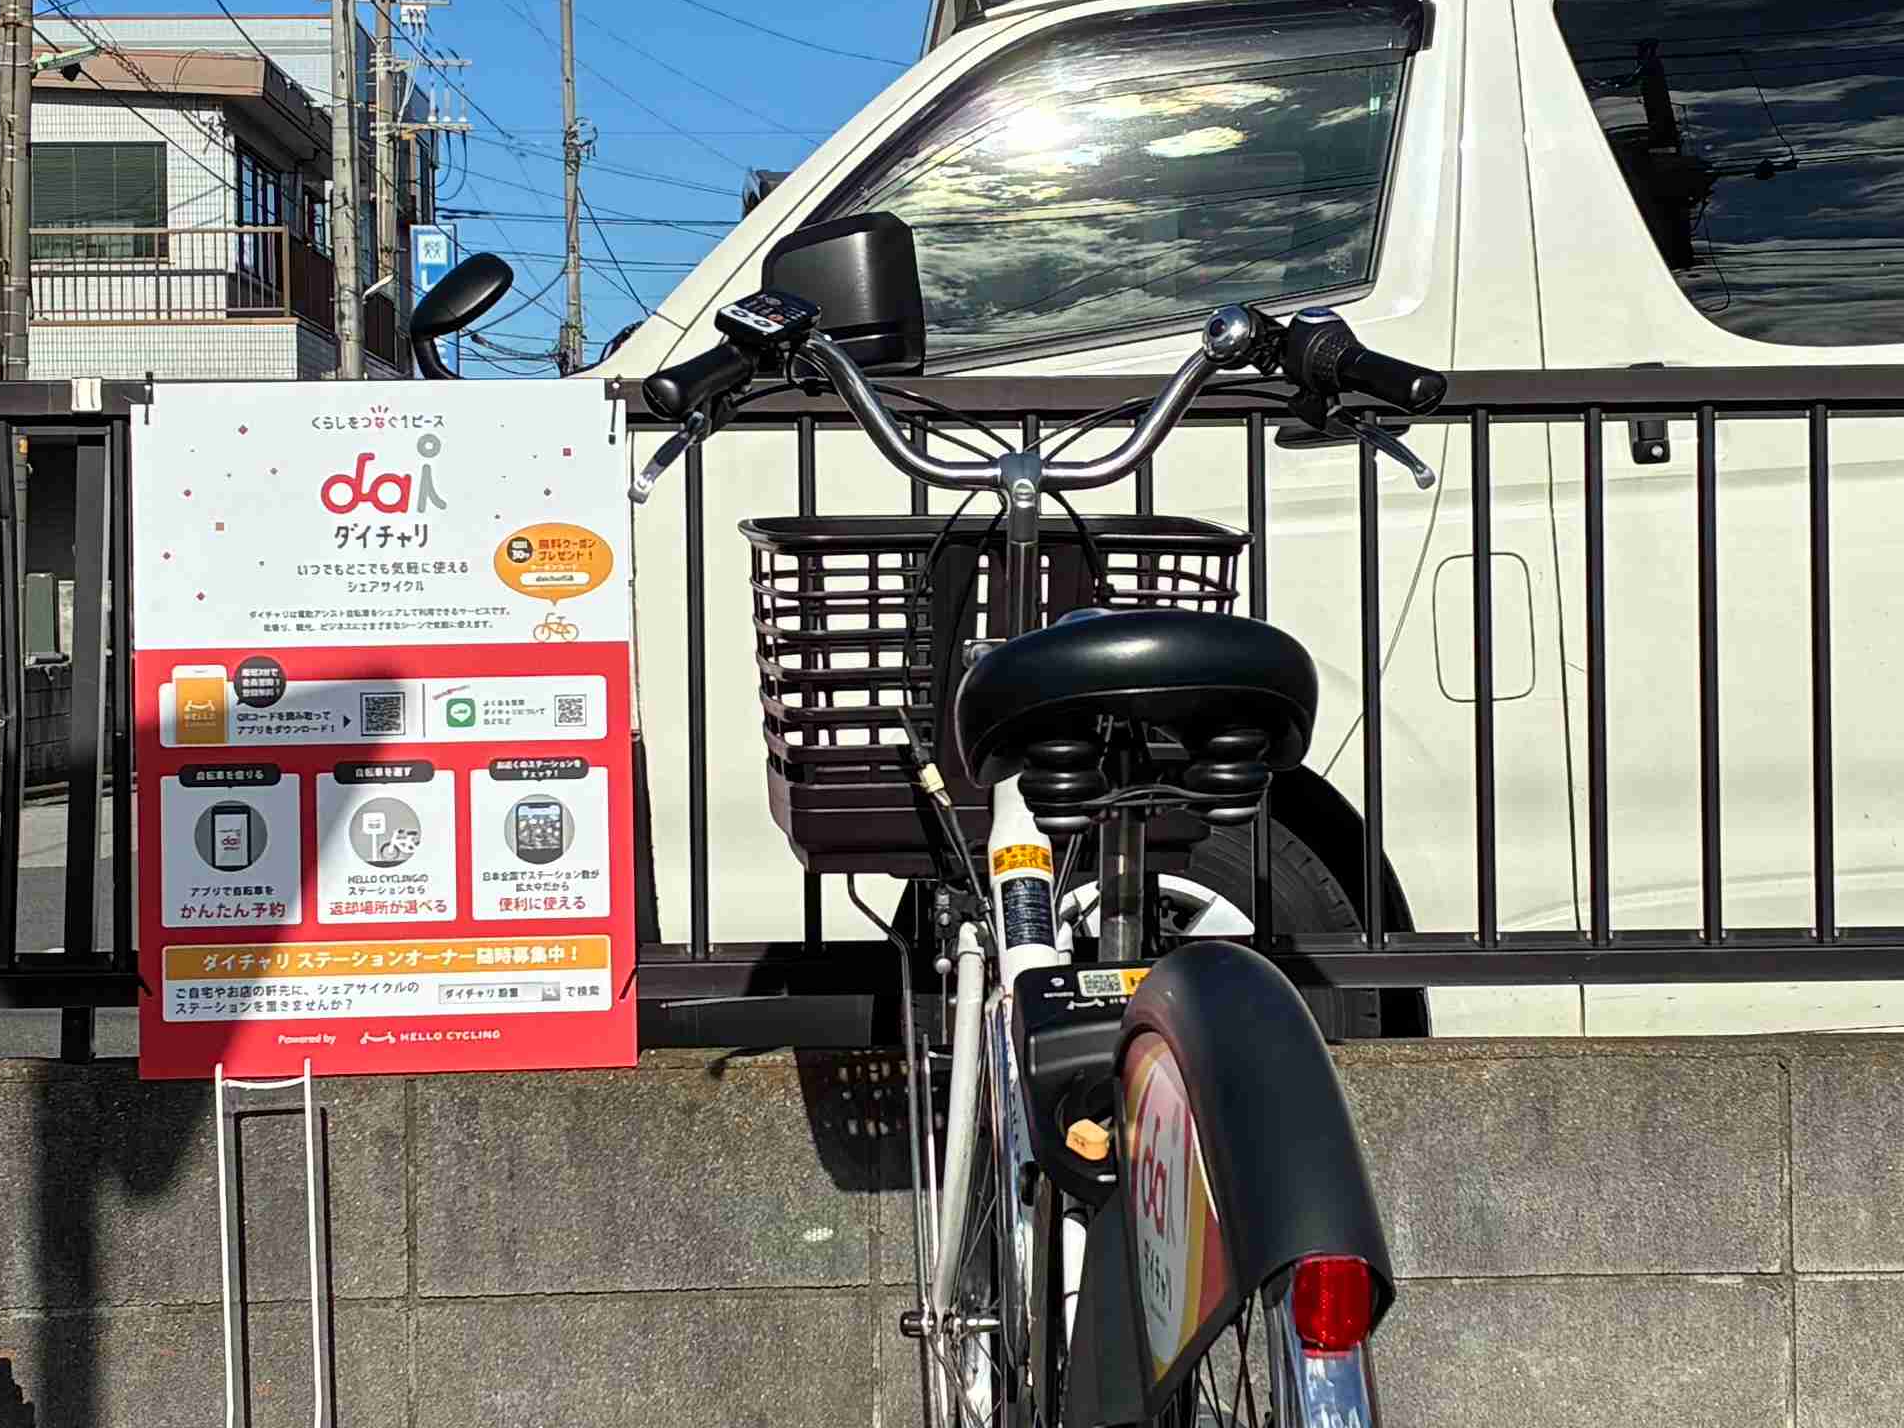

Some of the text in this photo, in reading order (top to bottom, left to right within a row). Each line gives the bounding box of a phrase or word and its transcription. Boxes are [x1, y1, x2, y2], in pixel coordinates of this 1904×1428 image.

[311, 414, 446, 430] くらしをつなぐ1ピース
[320, 433, 447, 514] dai
[334, 523, 429, 549] ダイチャリ
[296, 560, 470, 576] いつでもどこでも気軽に使える
[347, 580, 425, 593] シェアサイクル
[191, 885, 275, 897] アプリで自転車を
[348, 884, 425, 896] ステーションなら
[180, 902, 286, 919] かんたん予約
[330, 899, 447, 916] 返却場所が選べる
[499, 896, 586, 912] 便利に使える
[203, 953, 289, 972] ダイチャリ
[445, 988, 495, 999] ダイチャリ
[175, 999, 353, 1015] ステーションを置きませんか？
[278, 1034, 337, 1046] Powered by
[400, 1029, 501, 1042] HELLO CYCLING
